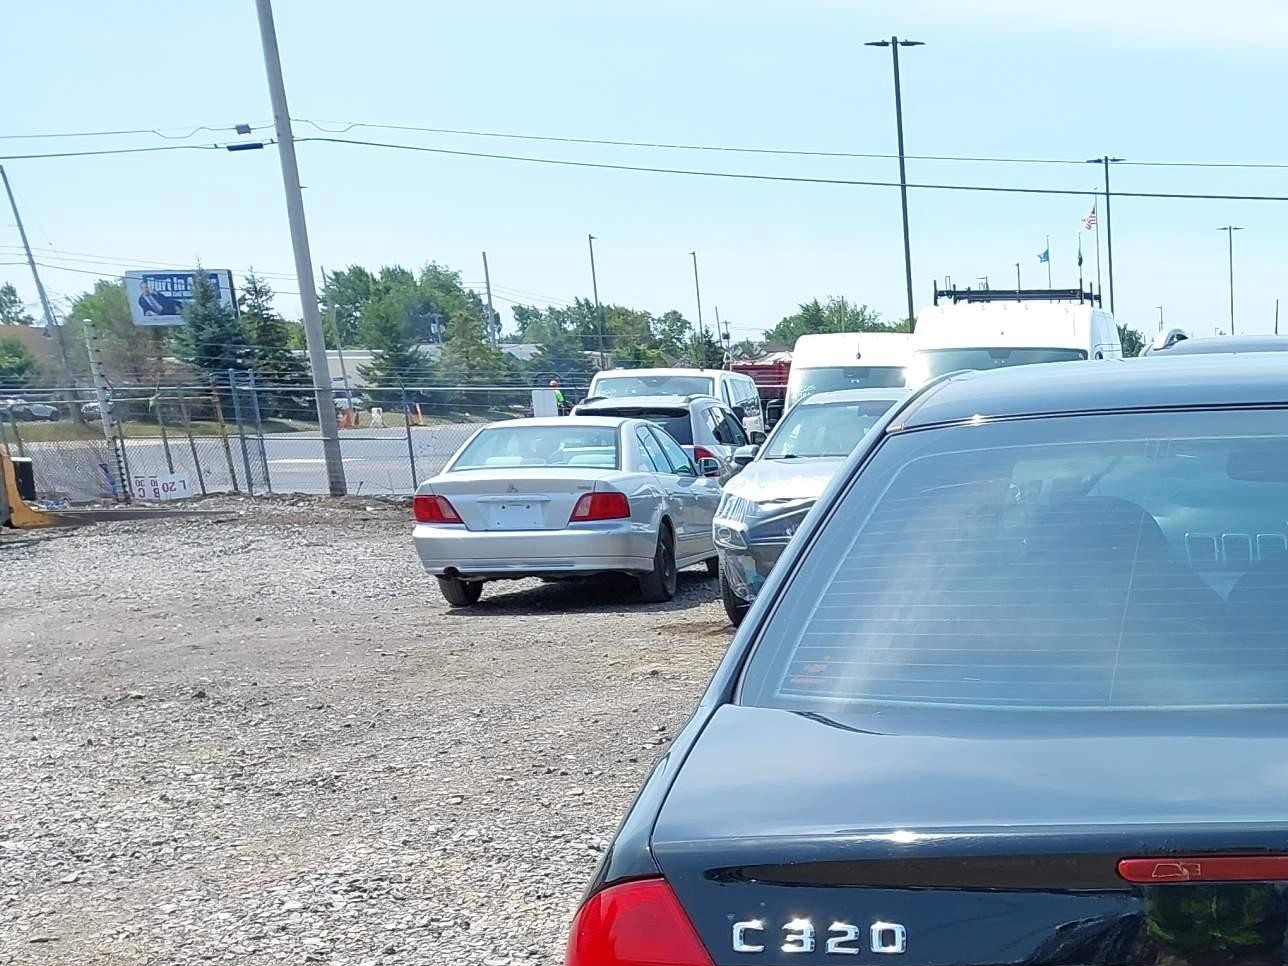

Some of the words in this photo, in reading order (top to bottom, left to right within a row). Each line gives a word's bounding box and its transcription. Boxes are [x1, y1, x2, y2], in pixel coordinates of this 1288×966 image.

[162, 481, 177, 493] 20
[732, 919, 766, 952] C
[780, 918, 907, 955] 320
